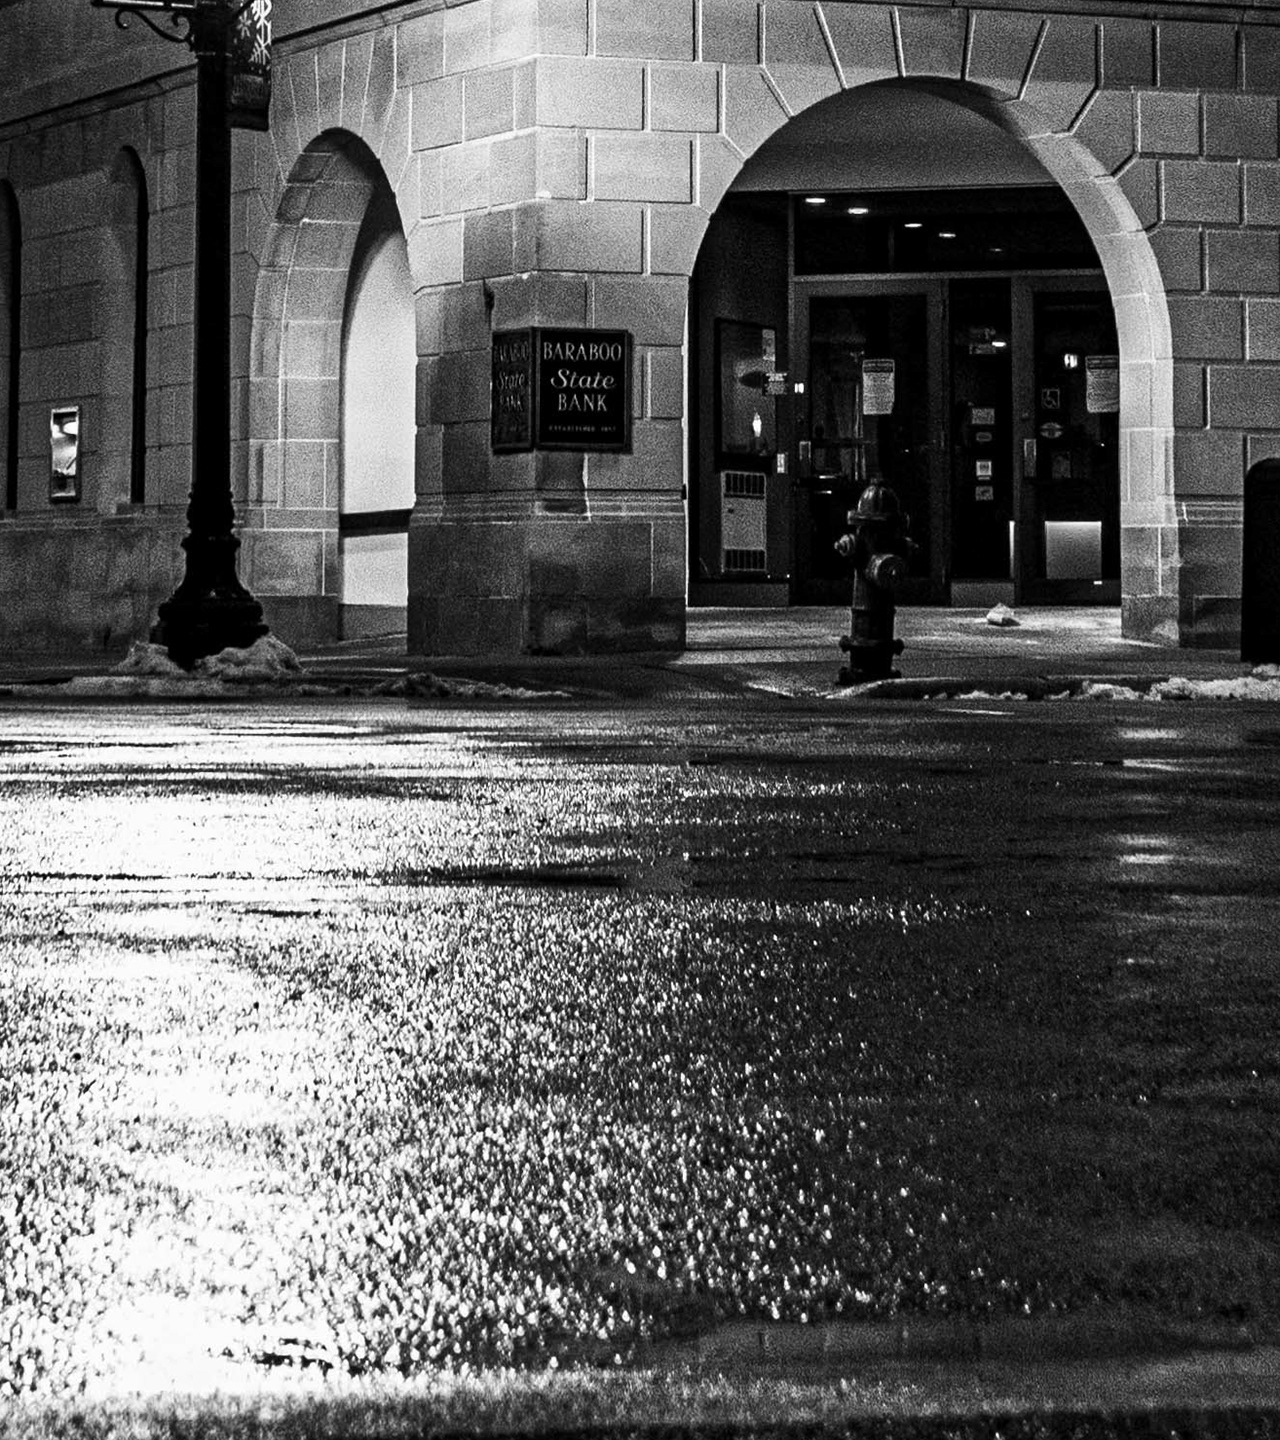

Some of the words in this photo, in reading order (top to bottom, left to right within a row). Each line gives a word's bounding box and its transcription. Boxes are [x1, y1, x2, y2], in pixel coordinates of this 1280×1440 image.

[543, 342, 622, 362] BARABOO
[551, 369, 616, 389] State
[558, 394, 608, 412] BANK
